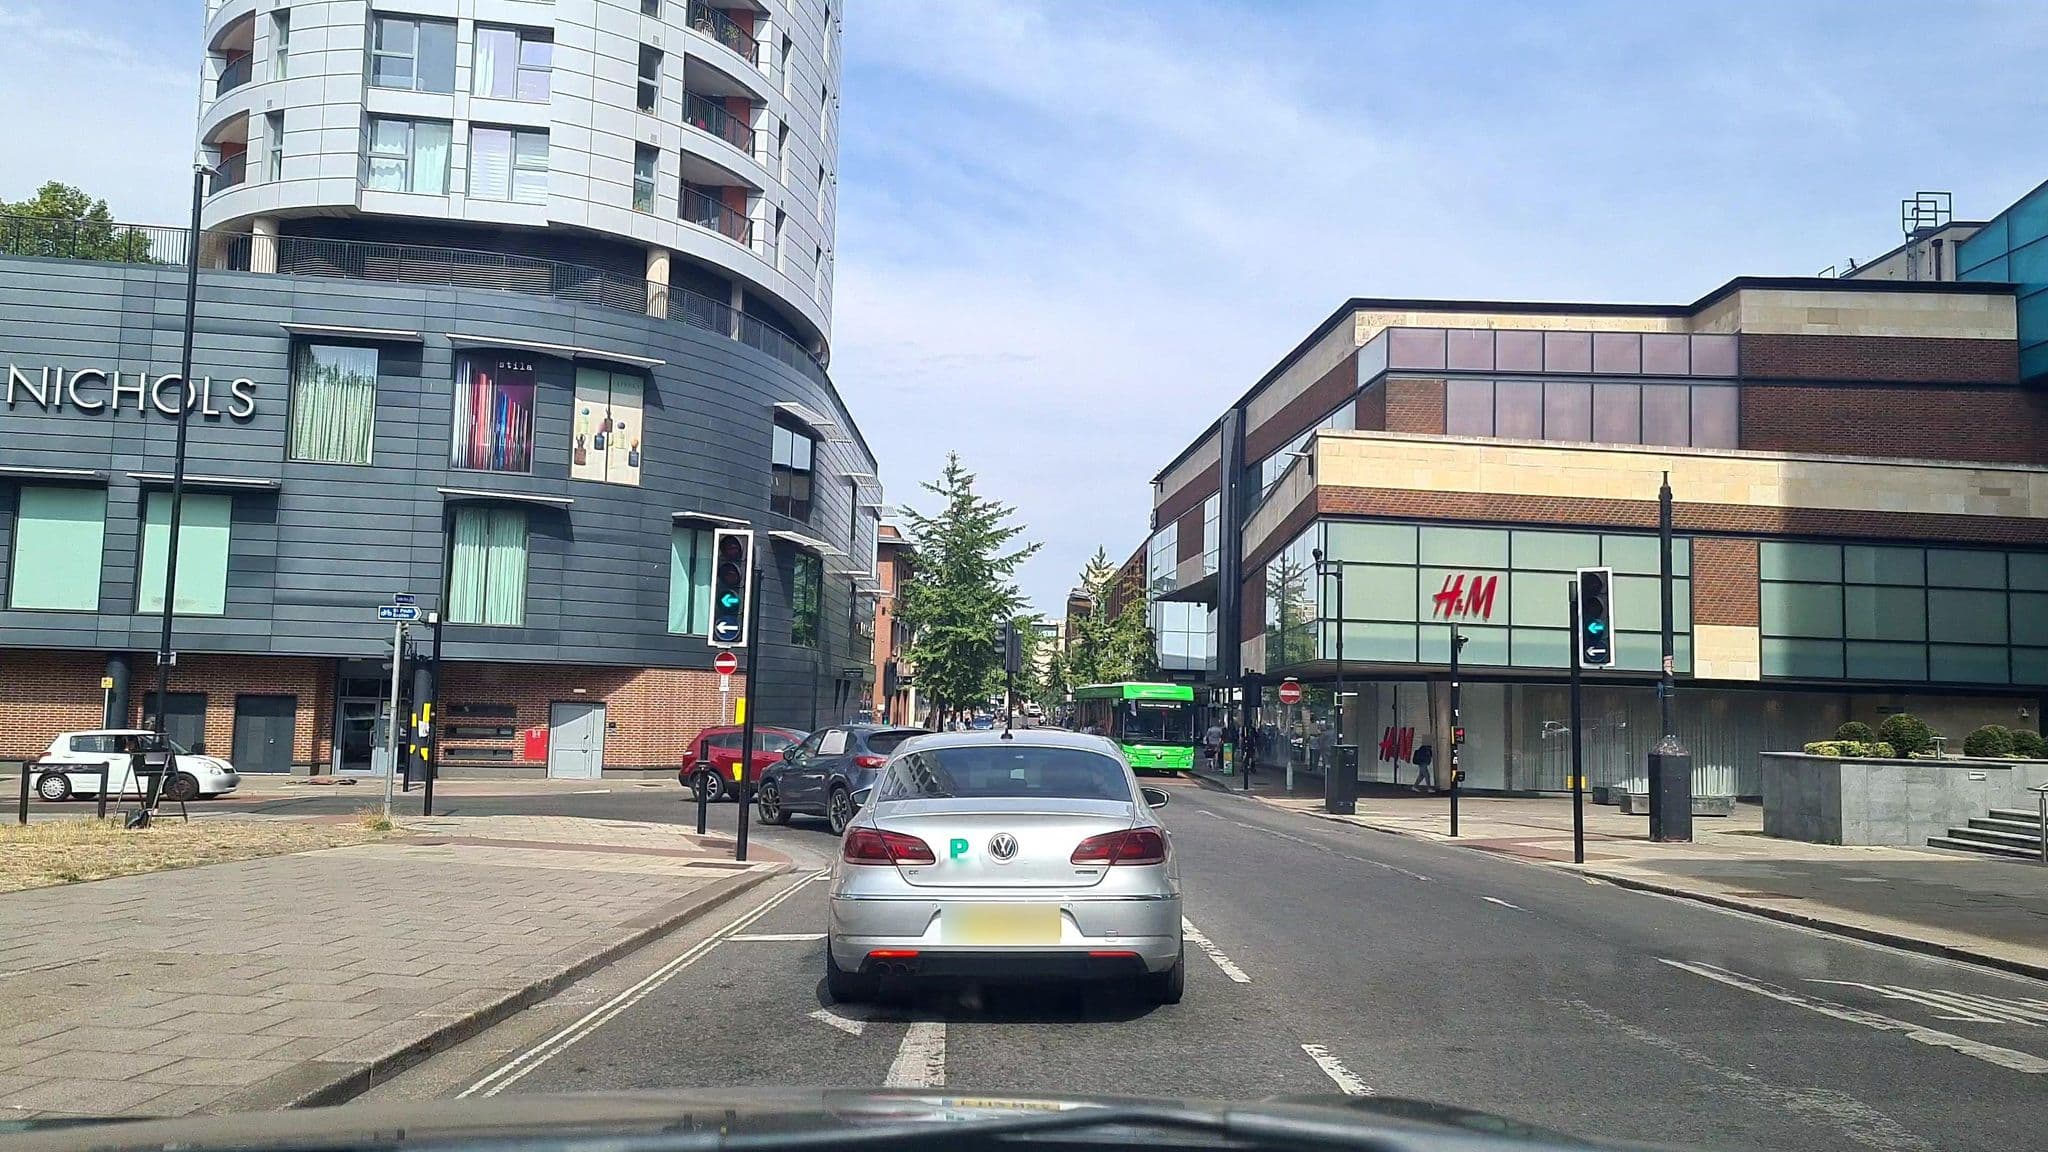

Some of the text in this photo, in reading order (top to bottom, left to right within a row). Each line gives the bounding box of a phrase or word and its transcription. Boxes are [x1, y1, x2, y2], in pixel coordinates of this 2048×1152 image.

[498, 361, 533, 371] stila
[6, 363, 257, 418] NICHOLS
[1432, 574, 1498, 621] H&M
[950, 838, 969, 860] P
